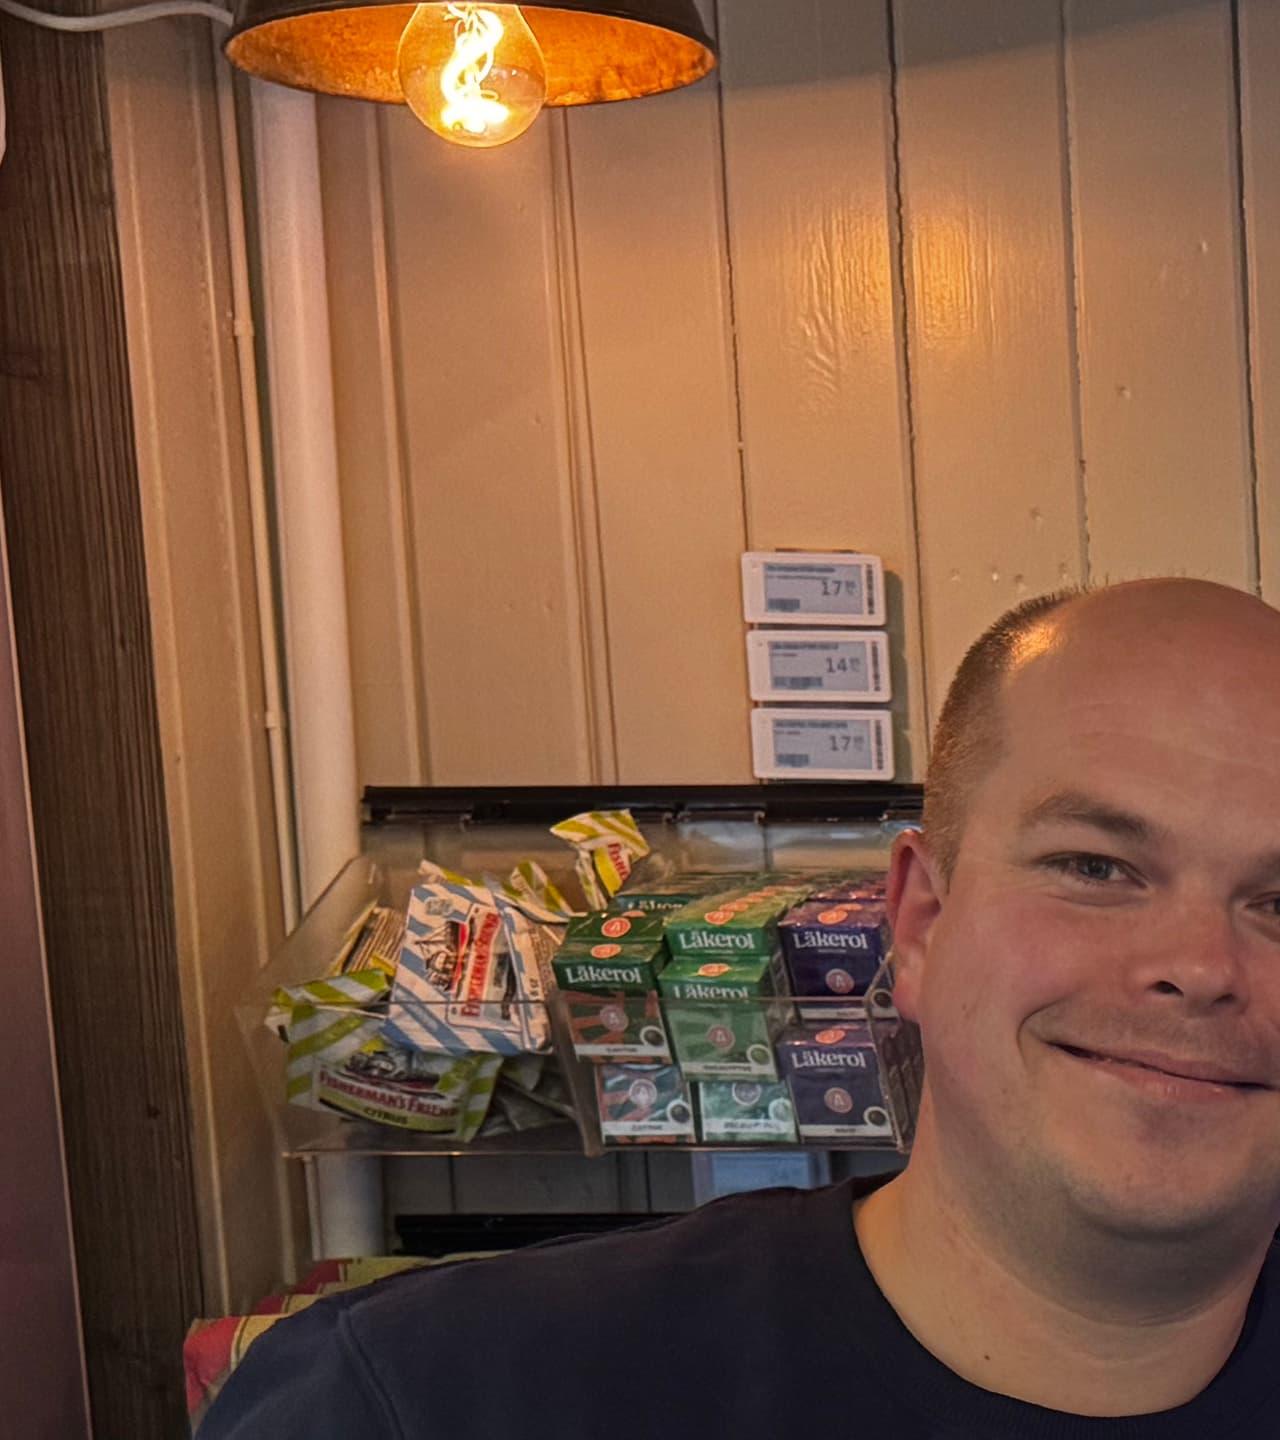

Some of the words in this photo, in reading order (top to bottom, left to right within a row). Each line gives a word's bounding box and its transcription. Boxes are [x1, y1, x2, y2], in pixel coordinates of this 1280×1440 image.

[821, 580, 842, 596] 17
[825, 657, 849, 673] 14
[829, 736, 851, 751] 17
[679, 930, 755, 949] Läkerol
[793, 931, 868, 949] Läkerol
[565, 966, 642, 985] Läkerol
[791, 1051, 867, 1069] Läkerol
